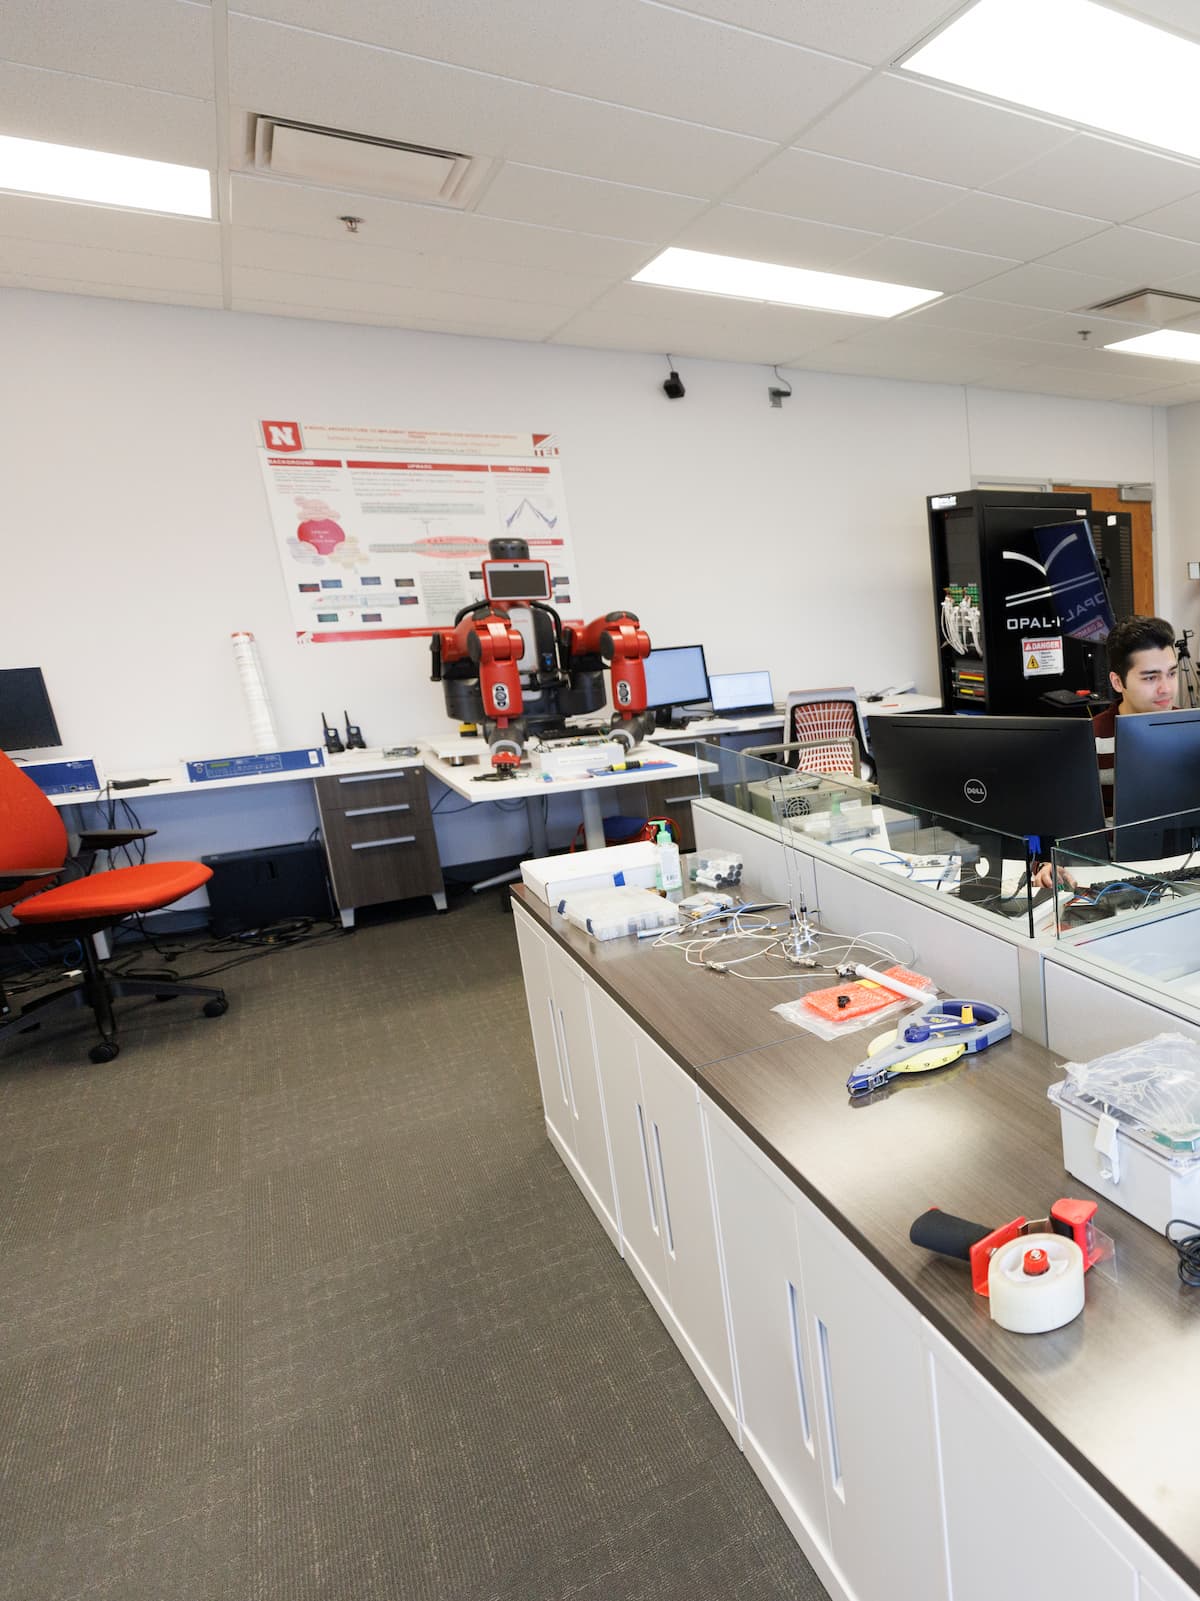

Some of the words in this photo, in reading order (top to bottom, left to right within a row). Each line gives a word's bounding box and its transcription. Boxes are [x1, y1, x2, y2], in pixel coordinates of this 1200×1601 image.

[268, 426, 296, 446] N
[1006, 616, 1060, 630] OPAL-
[1032, 641, 1060, 650] DANGER
[966, 787, 985, 795] DELL
